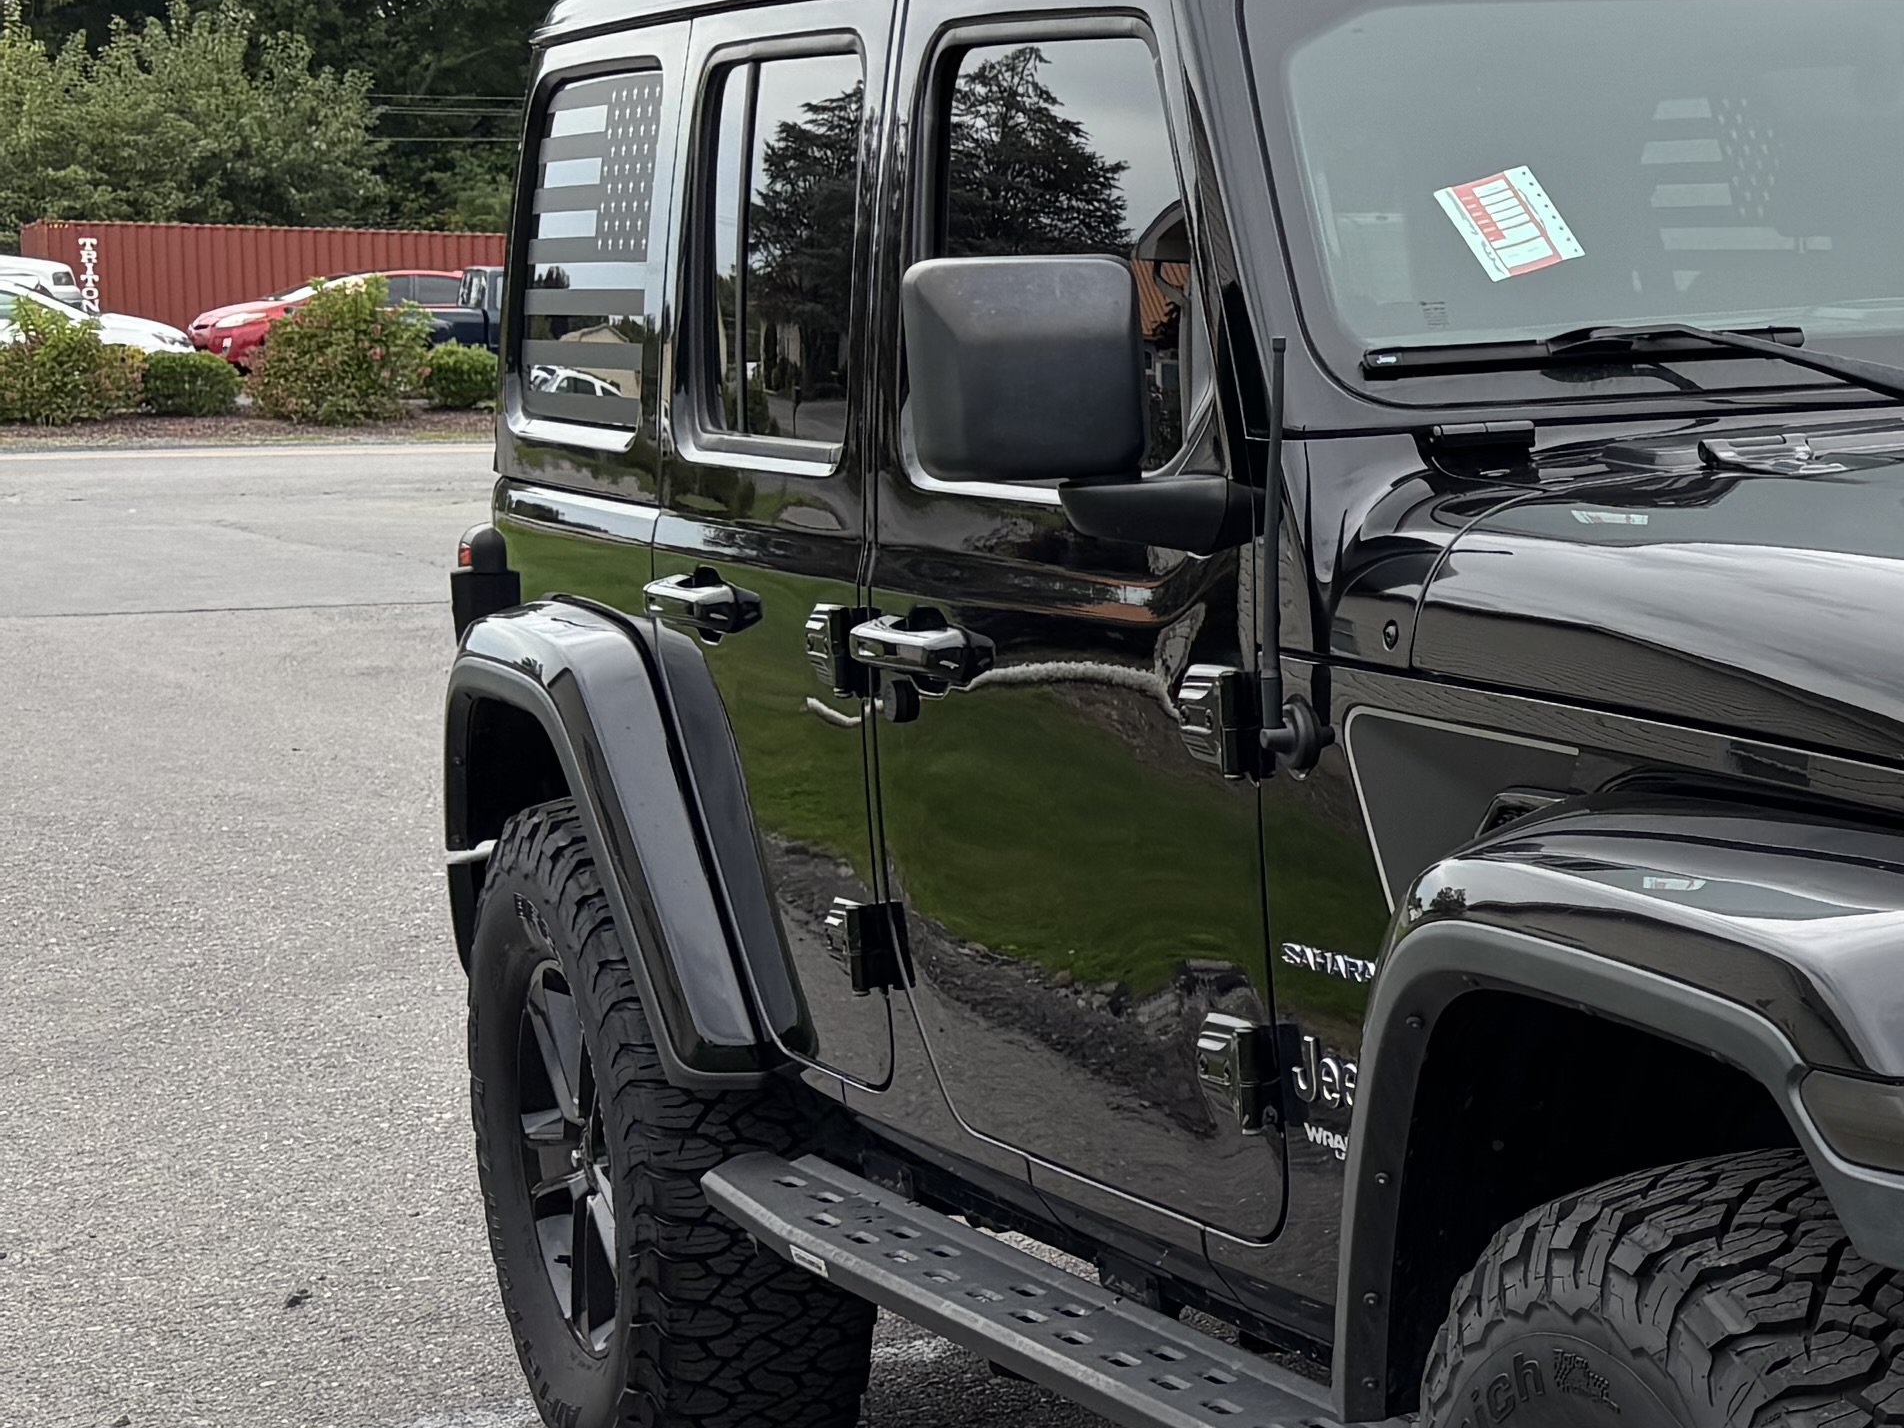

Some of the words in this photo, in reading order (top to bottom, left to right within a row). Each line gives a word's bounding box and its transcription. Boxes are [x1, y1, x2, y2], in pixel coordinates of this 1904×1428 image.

[78, 237, 100, 313] TRITON
[1281, 942, 1376, 983] SAHARA
[1291, 1035, 1358, 1110] Jee
[1304, 1122, 1349, 1153] WRA
